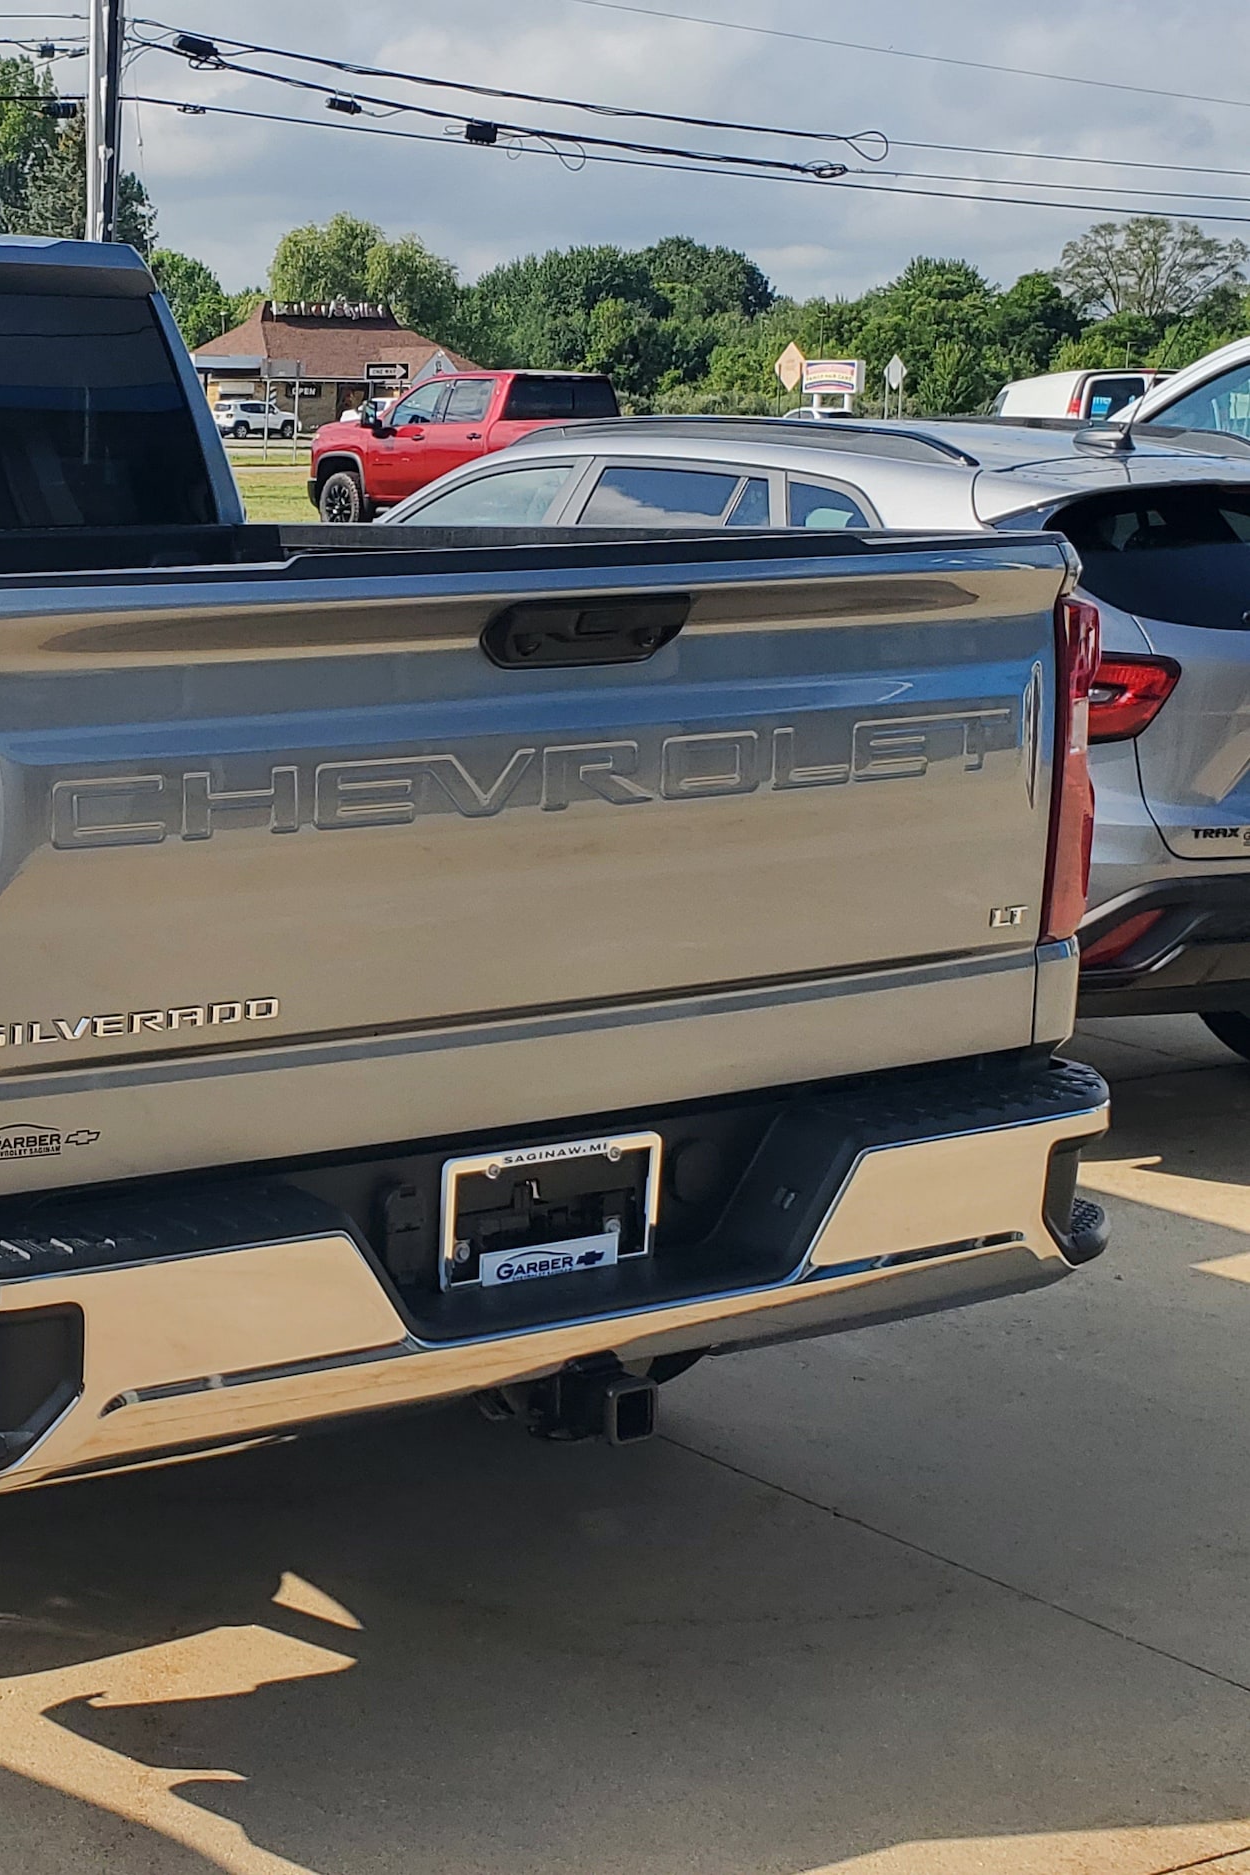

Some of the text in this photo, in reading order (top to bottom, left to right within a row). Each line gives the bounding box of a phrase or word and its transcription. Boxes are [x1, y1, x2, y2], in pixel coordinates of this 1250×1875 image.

[292, 386, 316, 395] OPEN
[51, 708, 1010, 850] CHEVROLET
[1191, 827, 1240, 839] TRAX
[989, 904, 1029, 928] LT
[30, 1145, 62, 1155] SAGINAW
[496, 1256, 573, 1280] GARBER
